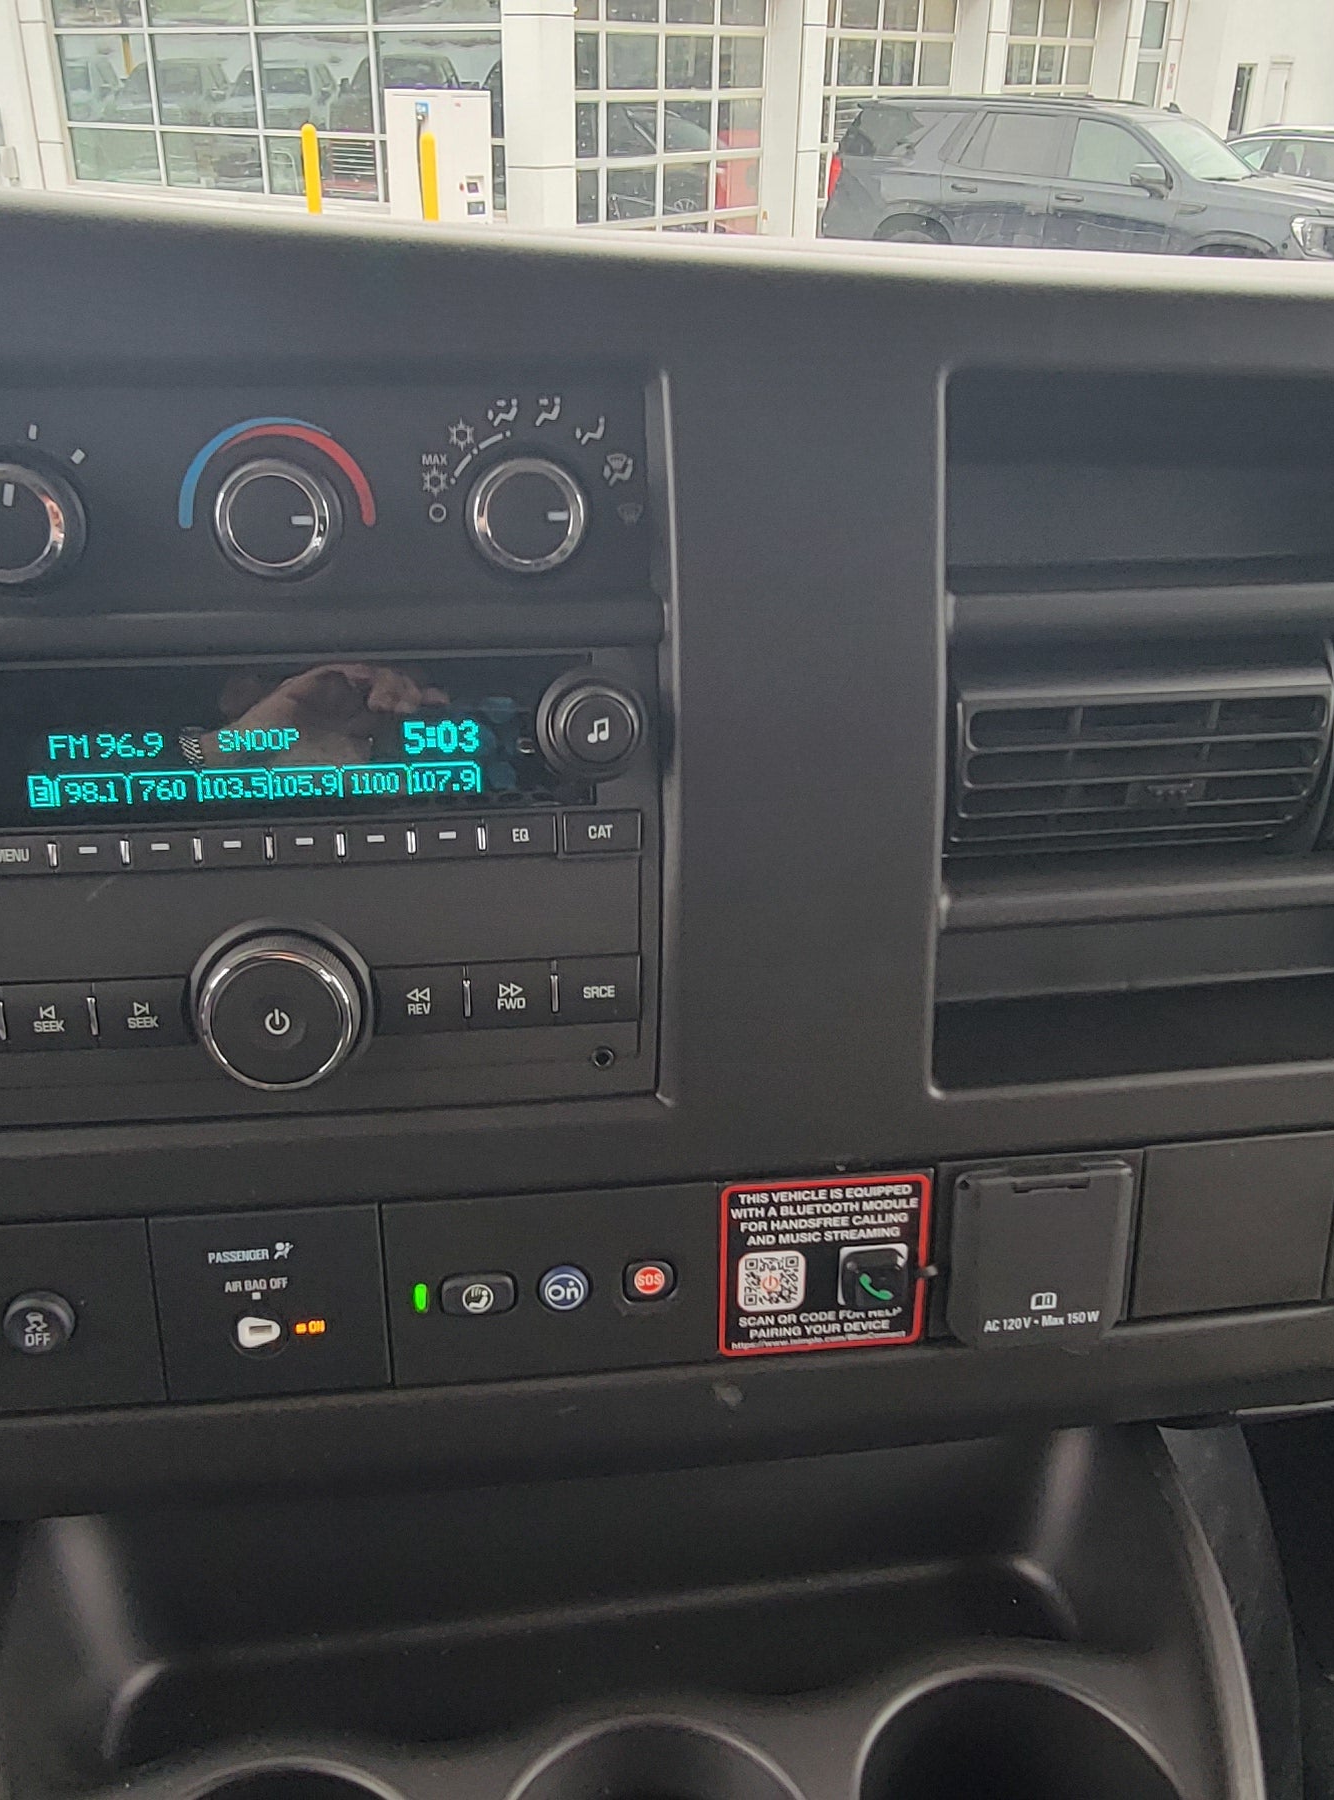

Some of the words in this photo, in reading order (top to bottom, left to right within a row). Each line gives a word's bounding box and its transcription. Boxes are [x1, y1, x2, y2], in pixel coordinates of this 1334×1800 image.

[422, 454, 448, 466] MAX
[47, 734, 91, 760] FM
[95, 732, 165, 759] 96.9
[218, 727, 300, 752] SNOOP
[402, 719, 480, 755] 5:03
[138, 779, 187, 802] 760
[202, 776, 269, 800] 103.5
[272, 773, 339, 798] 105.9
[350, 771, 400, 796] 1100
[413, 769, 477, 794] 107.9
[64, 781, 119, 804] 98.1
[512, 828, 530, 842] EQ
[587, 824, 614, 840] CAT
[583, 985, 616, 999] SRCE
[407, 1002, 431, 1016] REV
[497, 997, 526, 1011] FWD
[33, 1020, 65, 1033] SEEK
[127, 1016, 159, 1029] SEEK
[738, 1192, 769, 1205] THIS
[771, 1189, 828, 1203] VEHICLE
[829, 1188, 844, 1200] IS
[845, 1184, 913, 1199] EQUIPPED
[730, 1206, 766, 1220] WITH
[767, 1206, 778, 1218] A
[779, 1201, 860, 1217] BLUETOOTH
[862, 1197, 919, 1212] MODULE
[740, 1220, 768, 1233] FOR
[770, 1216, 850, 1231] HANDSFREE
[852, 1212, 909, 1226] CALLING
[746, 1234, 776, 1246] AND
[778, 1231, 822, 1244] MUSIC
[824, 1226, 901, 1241] STREAMING
[208, 1248, 270, 1264] PASSENGER
[224, 1280, 243, 1293] AIR
[244, 1278, 267, 1291] BAG
[269, 1276, 288, 1290] OFF
[637, 1273, 663, 1287] SOS
[308, 1319, 326, 1334] ON
[738, 1316, 775, 1328] SCAN
[777, 1313, 797, 1325] QR
[799, 1310, 836, 1322] CODE
[983, 1320, 1000, 1332] AC
[1041, 1314, 1065, 1327] Max
[749, 1326, 802, 1340] PAIRING
[805, 1323, 841, 1336] YOUR
[843, 1319, 890, 1333] DEVICE
[24, 1333, 51, 1348] OFF
